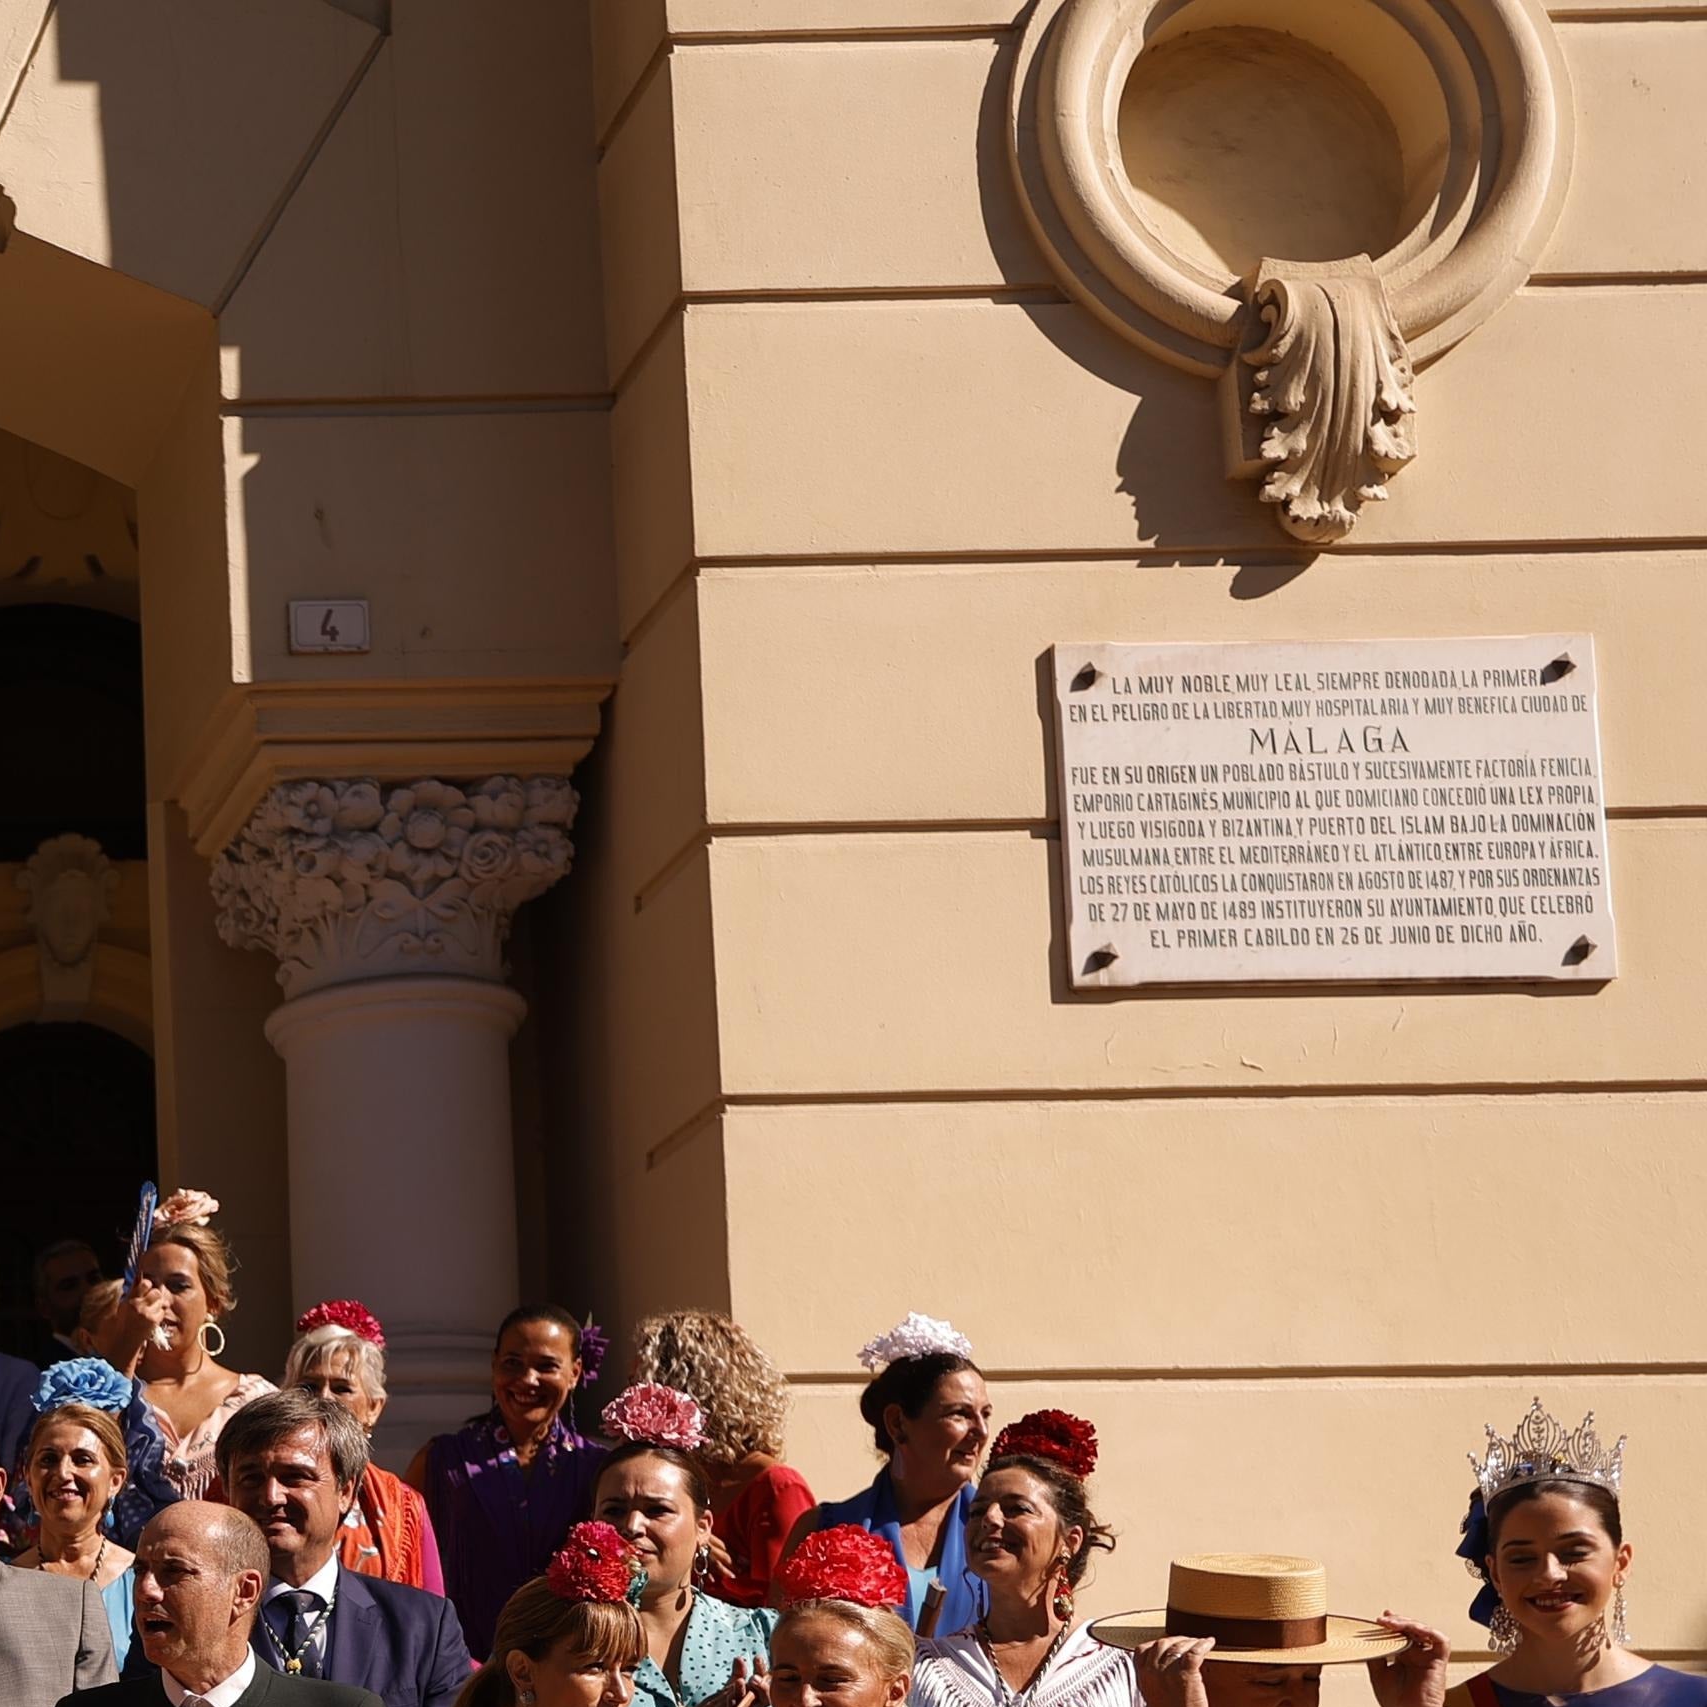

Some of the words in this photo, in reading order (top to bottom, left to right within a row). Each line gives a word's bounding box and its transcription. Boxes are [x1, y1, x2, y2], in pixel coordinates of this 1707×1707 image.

[321, 608, 339, 641] 4
[1112, 677, 1132, 695] LA
[1138, 676, 1174, 694] MUY
[1236, 674, 1268, 693] MUY
[1317, 672, 1380, 690] SIEMPRE
[1462, 670, 1478, 689] LA
[1070, 704, 1087, 723] EN
[1092, 704, 1108, 722] EL
[1113, 703, 1168, 722] PELIGRO
[1173, 703, 1189, 720] DE
[1193, 702, 1210, 719] LA
[1281, 700, 1311, 718] MUY
[1316, 698, 1409, 717] HOSPITALARIA
[1412, 698, 1419, 715] Y
[1424, 697, 1453, 715] MUY
[1521, 695, 1568, 713] CIUDAD
[1572, 695, 1588, 712] DE
[1249, 721, 1410, 756] MÁLAGA
[1071, 766, 1097, 786] FUE
[1102, 766, 1120, 785] EN
[1124, 765, 1143, 784] SU
[1147, 764, 1196, 784] ORIGEN
[1201, 764, 1218, 783] UN
[1223, 763, 1284, 783] POBLADO
[1353, 762, 1359, 780] Y
[1365, 760, 1472, 780] SUCESIVAMENTE
[1073, 792, 1133, 813] EMPORIO
[1222, 790, 1290, 811] MUNICIPIO
[1295, 791, 1311, 809] AL
[1315, 789, 1340, 811] QUE
[1346, 788, 1418, 808] DOMICIANO
[1490, 786, 1515, 806] UNA
[1519, 786, 1543, 805] LEX
[1077, 822, 1085, 840] Y
[1090, 821, 1135, 840] LUEGO
[1140, 819, 1205, 839] VISIGODA
[1209, 819, 1217, 838] Y
[1296, 818, 1303, 837] Y
[1309, 817, 1365, 836] PUERTO
[1370, 816, 1396, 835] DEL
[1401, 816, 1445, 835] ISLAM
[1450, 815, 1486, 834] BAJO
[1490, 815, 1507, 833] LA
[1174, 847, 1215, 866] ENTRE
[1219, 847, 1235, 865] EL
[1343, 844, 1351, 863] Y
[1354, 845, 1369, 862] EL
[1445, 842, 1483, 861] ENTRE
[1488, 841, 1536, 860] EUROPA
[1538, 841, 1545, 859] Y
[1080, 876, 1103, 895] LOS
[1108, 875, 1147, 894] REYES
[1222, 873, 1237, 892] LA
[1241, 872, 1334, 894] CONQUISTARON
[1338, 872, 1353, 890] EN
[1358, 872, 1404, 890] AGOSTO
[1408, 871, 1423, 889] DE
[1459, 870, 1465, 888] Y
[1469, 870, 1493, 888] POR
[1497, 869, 1519, 887] SUS
[1523, 867, 1600, 887] ORDENANZAS
[1088, 903, 1105, 922] DE
[1111, 903, 1128, 922] 27
[1133, 902, 1151, 921] DE
[1156, 902, 1196, 921] MAYO
[1201, 901, 1218, 920] DE
[1223, 901, 1256, 920] 1489
[1261, 899, 1363, 919] INSTITUYERON
[1367, 898, 1384, 917] SU
[1499, 896, 1525, 918] QUE
[1150, 930, 1170, 948] EL
[1177, 928, 1237, 948] PRIMER
[1244, 928, 1310, 947] CABILDO
[1316, 927, 1334, 946] EN
[1341, 927, 1359, 945] 26
[1365, 926, 1383, 945] DE
[1389, 926, 1431, 944] JUNIO
[1436, 926, 1454, 943] DE
[1461, 925, 1502, 943] DICHO
